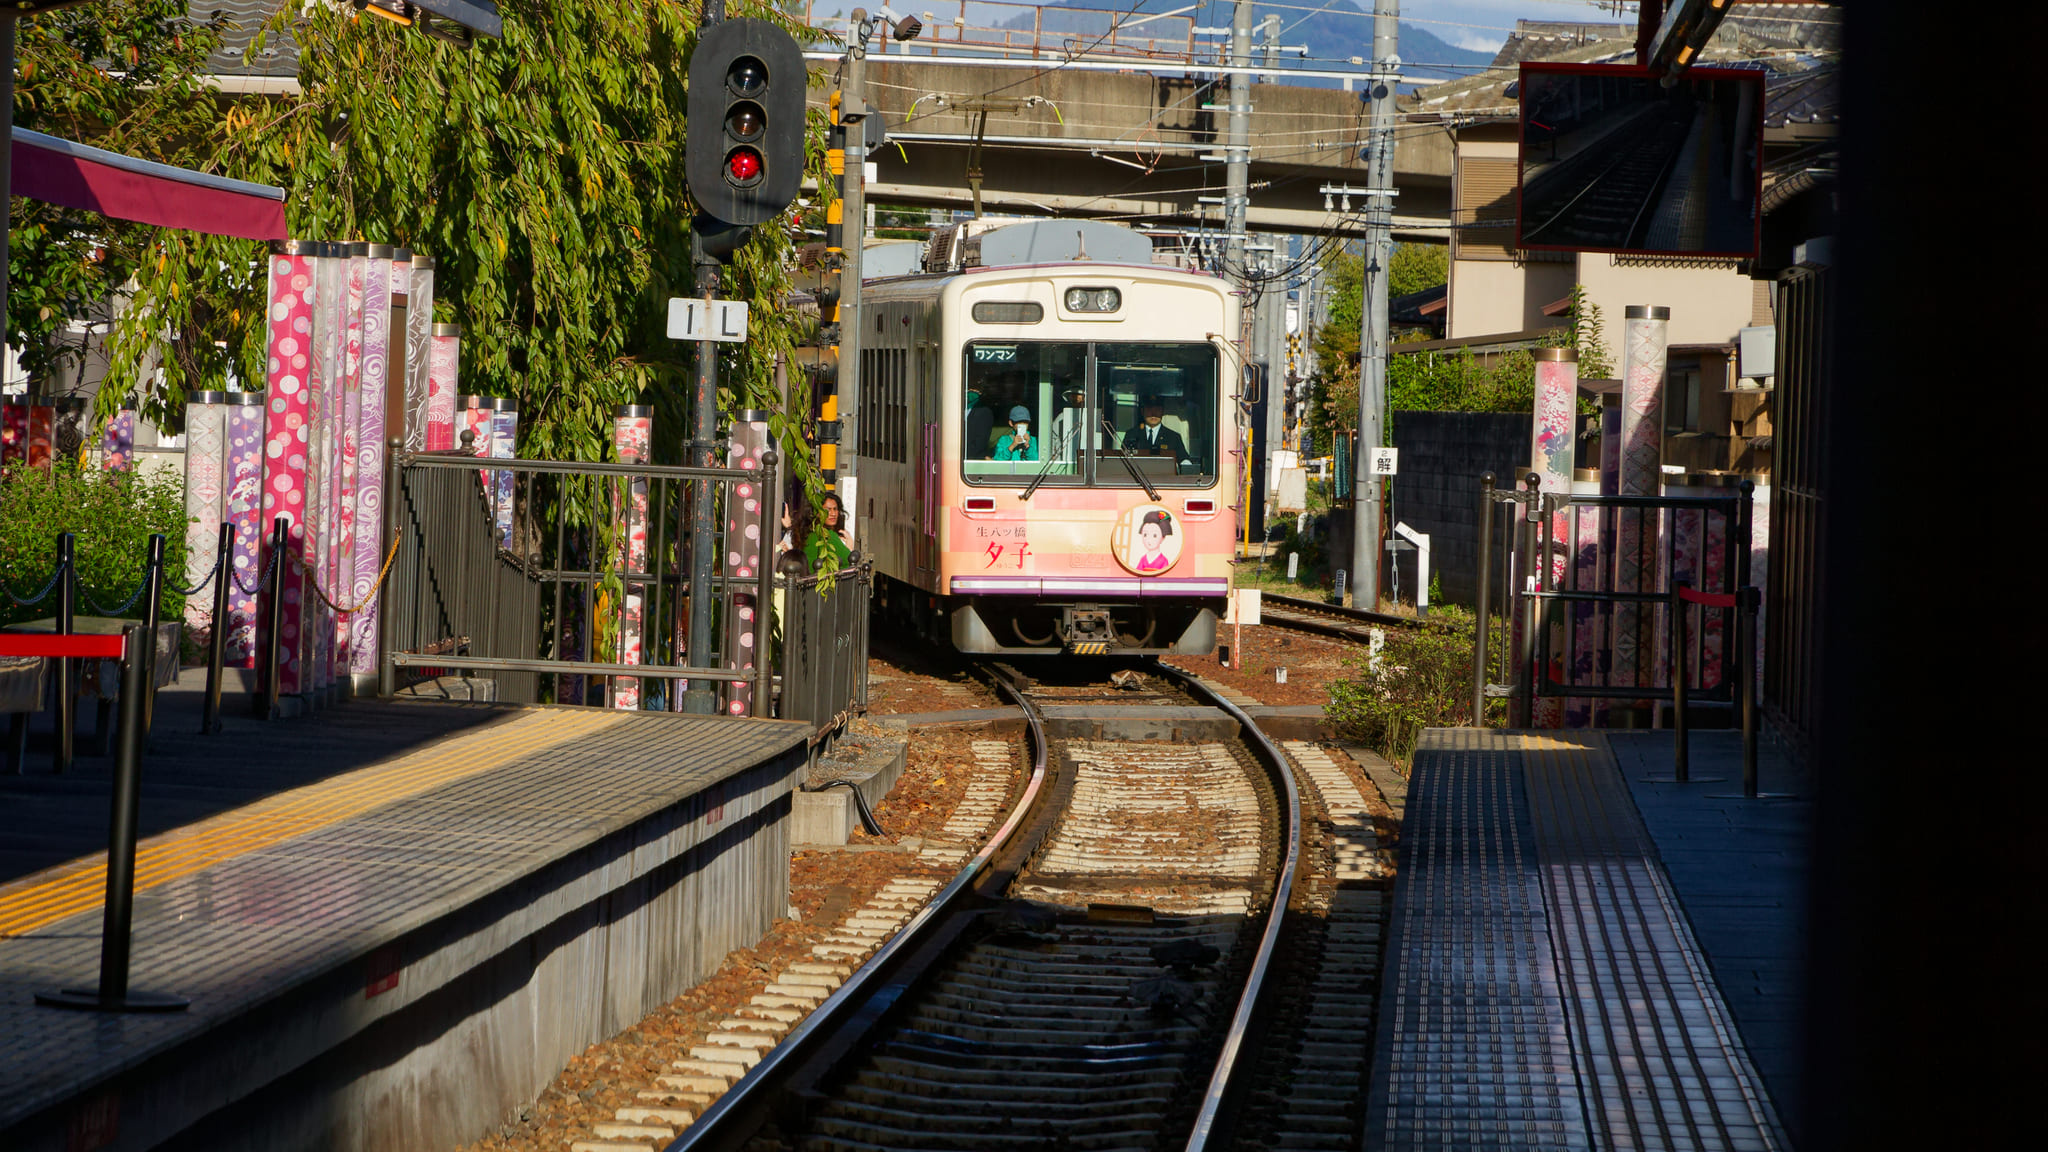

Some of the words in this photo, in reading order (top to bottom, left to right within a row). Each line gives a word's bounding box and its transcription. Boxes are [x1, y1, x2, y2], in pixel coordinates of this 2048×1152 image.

[721, 305, 739, 336] L
[975, 350, 1016, 360] ワンマン
[1377, 457, 1391, 472] 解
[984, 541, 1032, 570] 夕子
